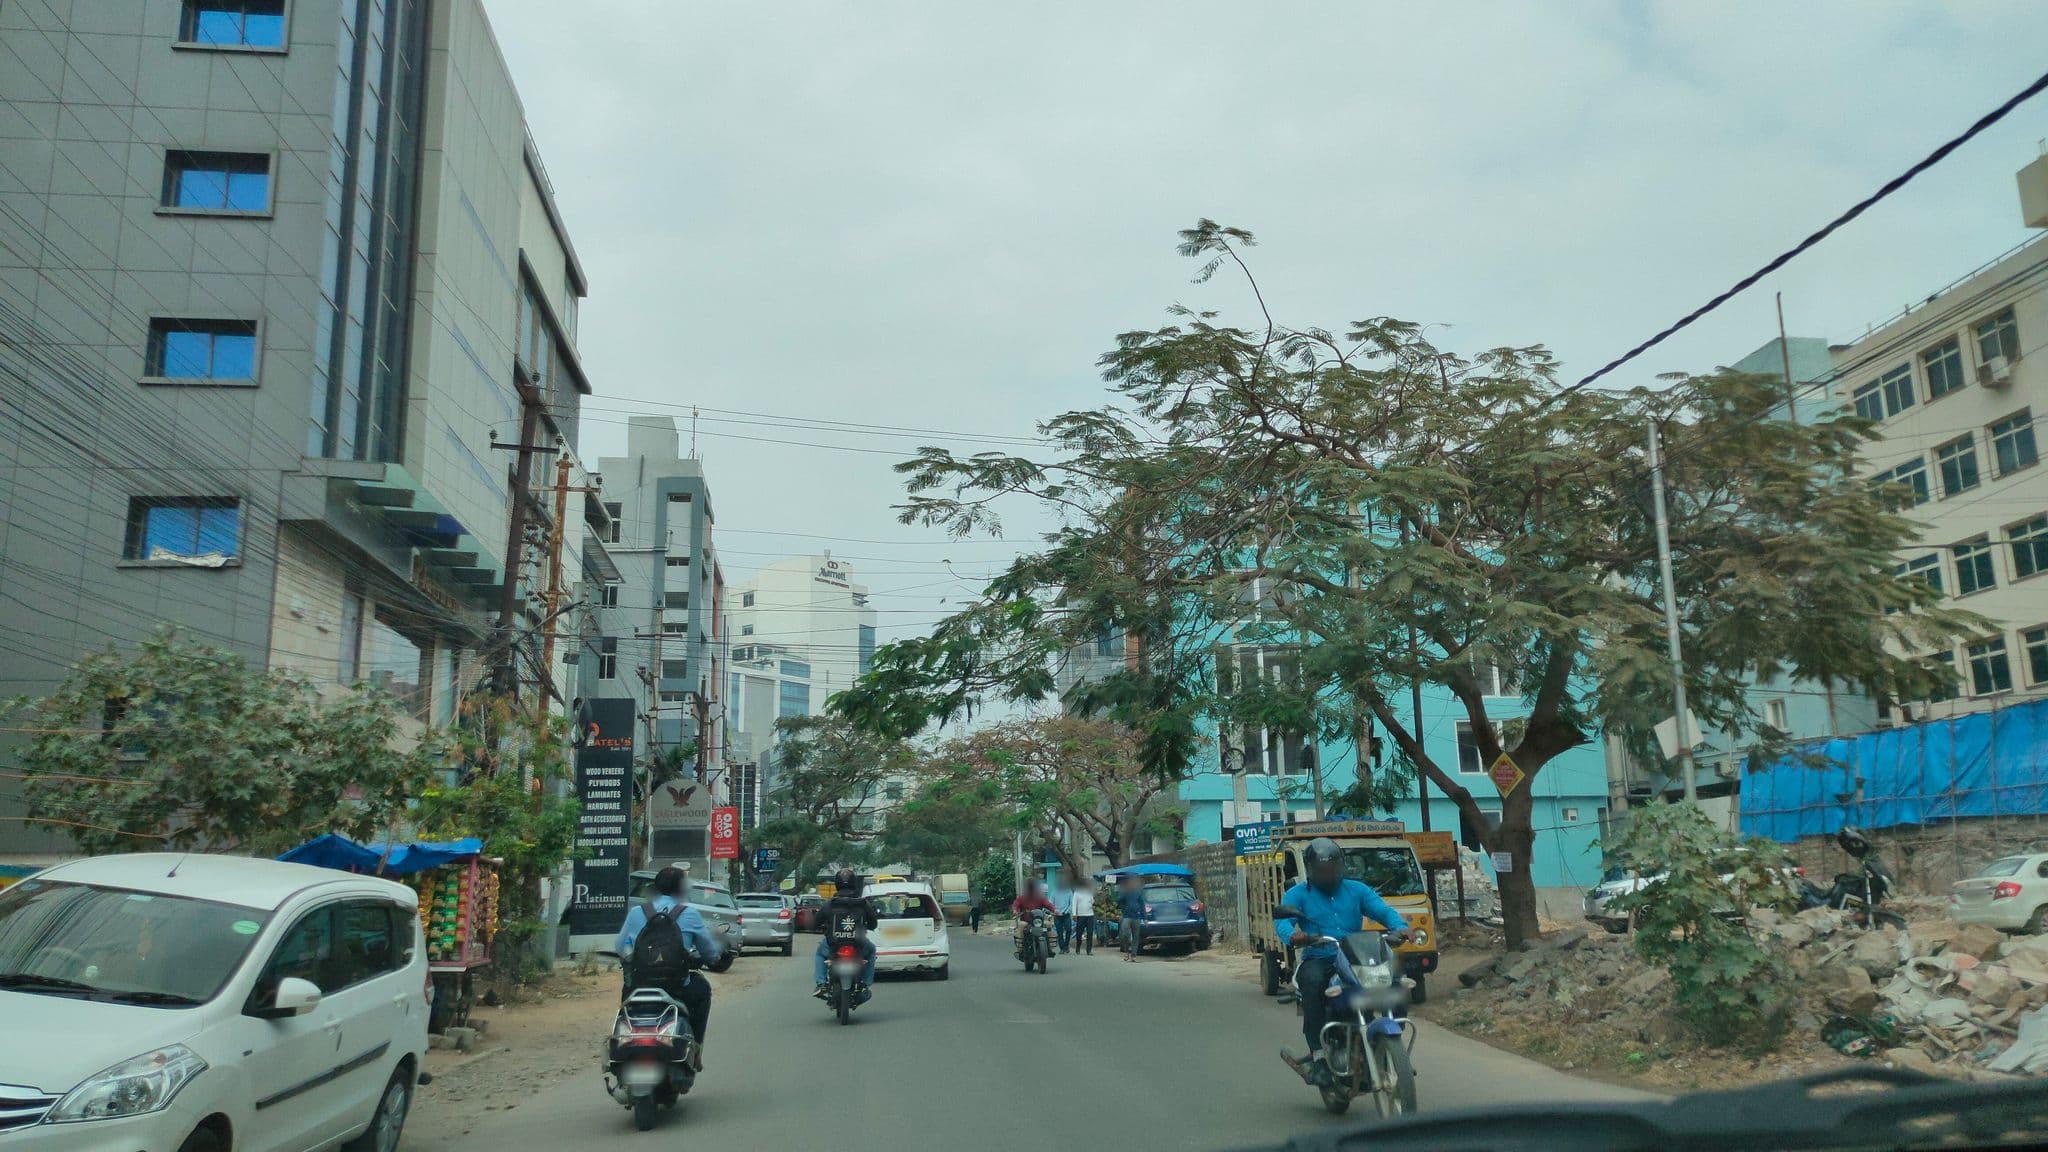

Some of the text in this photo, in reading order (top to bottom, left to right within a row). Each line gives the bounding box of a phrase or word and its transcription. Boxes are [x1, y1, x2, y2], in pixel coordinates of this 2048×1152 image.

[585, 767, 625, 775] WOOD VENEERS
[588, 779, 621, 787] PLYWOODS
[587, 790, 621, 799] LAMINATES
[587, 802, 621, 810] HARDWARE
[580, 815, 626, 823] BATH ACCESSORIES
[723, 813, 733, 838] OYO
[597, 826, 622, 834] LIGHTERS
[1236, 827, 1258, 838] avn
[602, 838, 628, 846] KITCHENS
[585, 858, 619, 867] WARDROBES
[574, 884, 626, 903] Platinum
